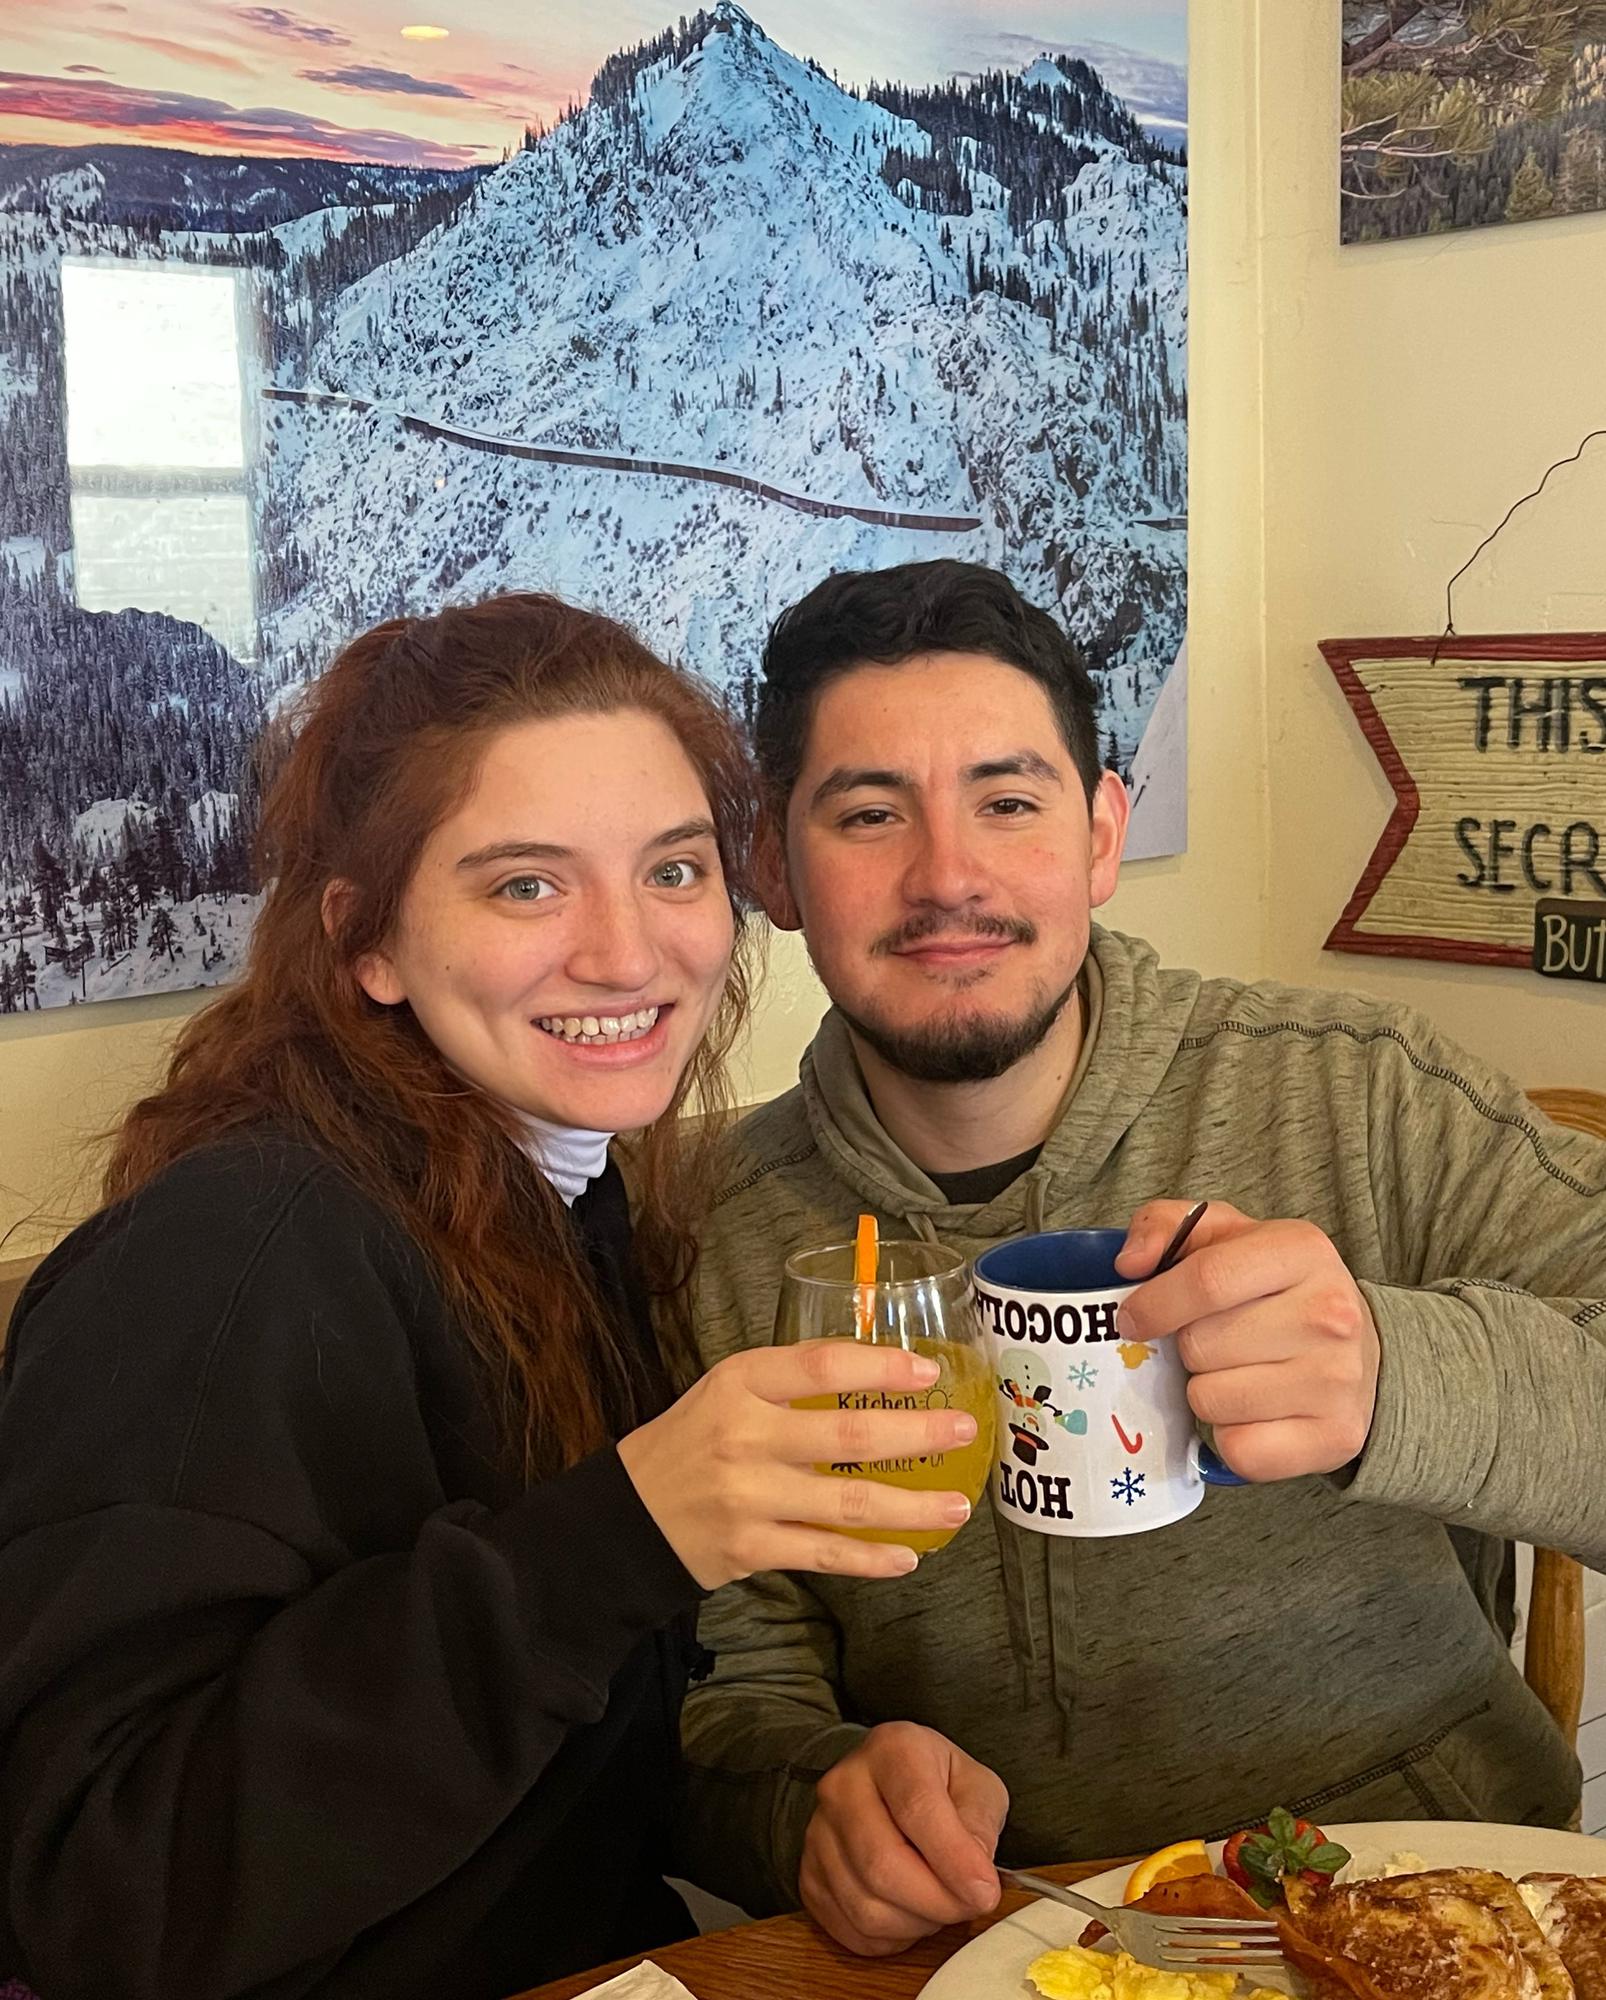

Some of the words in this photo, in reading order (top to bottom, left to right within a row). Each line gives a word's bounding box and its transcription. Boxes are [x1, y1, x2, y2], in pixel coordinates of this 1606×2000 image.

[1456, 677, 1606, 752] THIS
[837, 1391, 917, 1409] Kitchen
[999, 1460, 1073, 1519] HOT
